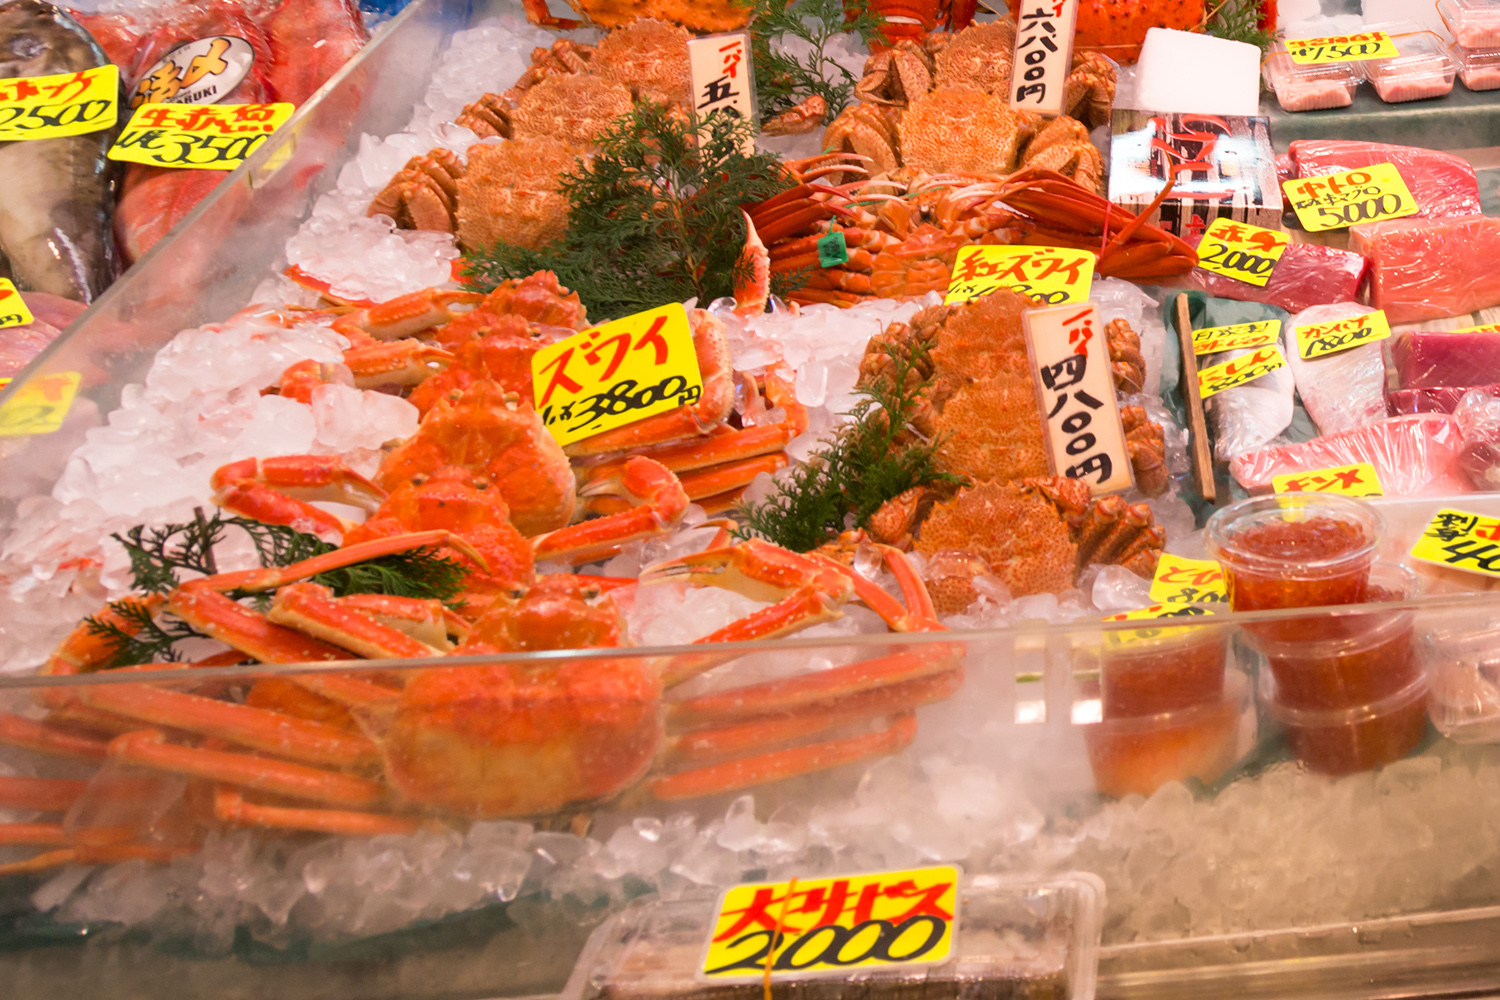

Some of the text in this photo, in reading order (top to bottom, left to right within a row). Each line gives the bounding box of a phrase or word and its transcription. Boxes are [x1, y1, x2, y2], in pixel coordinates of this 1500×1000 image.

[1297, 172, 1372, 199] 中トロ
[1209, 224, 1288, 252] 赤身
[951, 248, 1088, 285] 紅ズワイ
[538, 316, 668, 409] ズワイ
